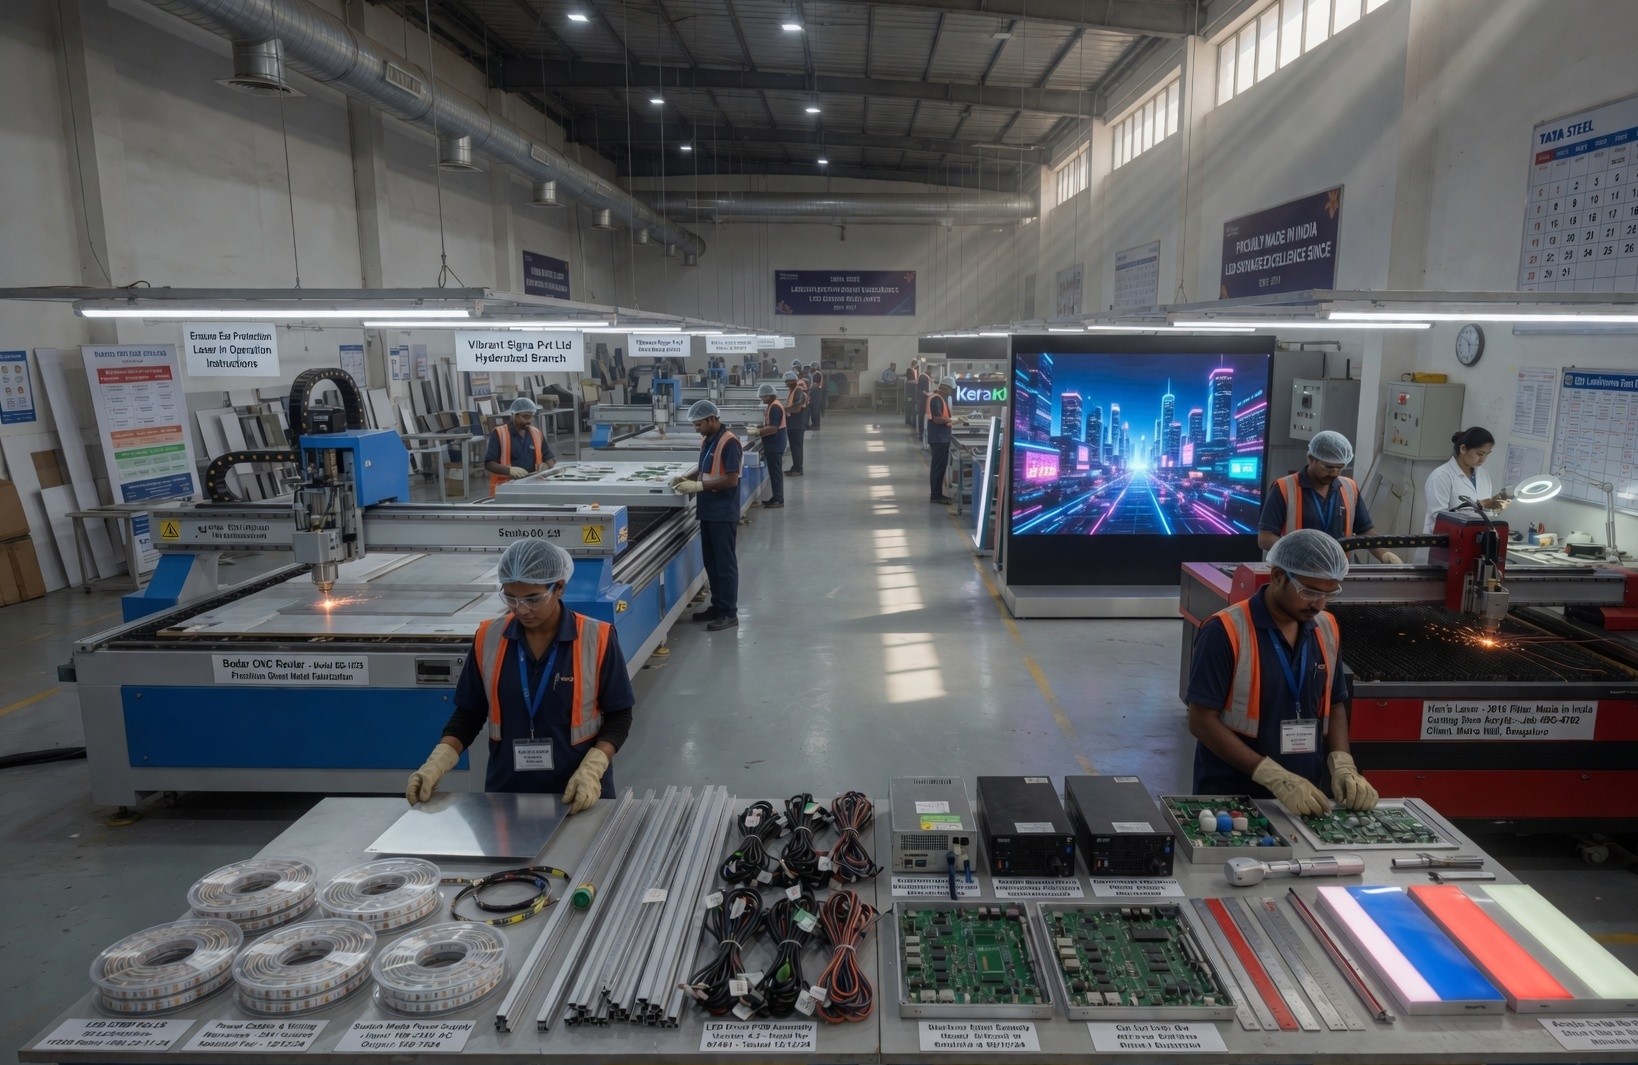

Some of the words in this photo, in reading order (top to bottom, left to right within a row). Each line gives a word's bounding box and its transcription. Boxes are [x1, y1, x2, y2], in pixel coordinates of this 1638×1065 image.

[1540, 128, 1565, 145] TATA
[1567, 120, 1594, 138] STEEL
[1287, 226, 1294, 243] IN
[1296, 221, 1318, 242] INDIA
[1603, 245, 1613, 255] 25
[1624, 243, 1634, 253] 26
[468, 340, 504, 350] Vibrant
